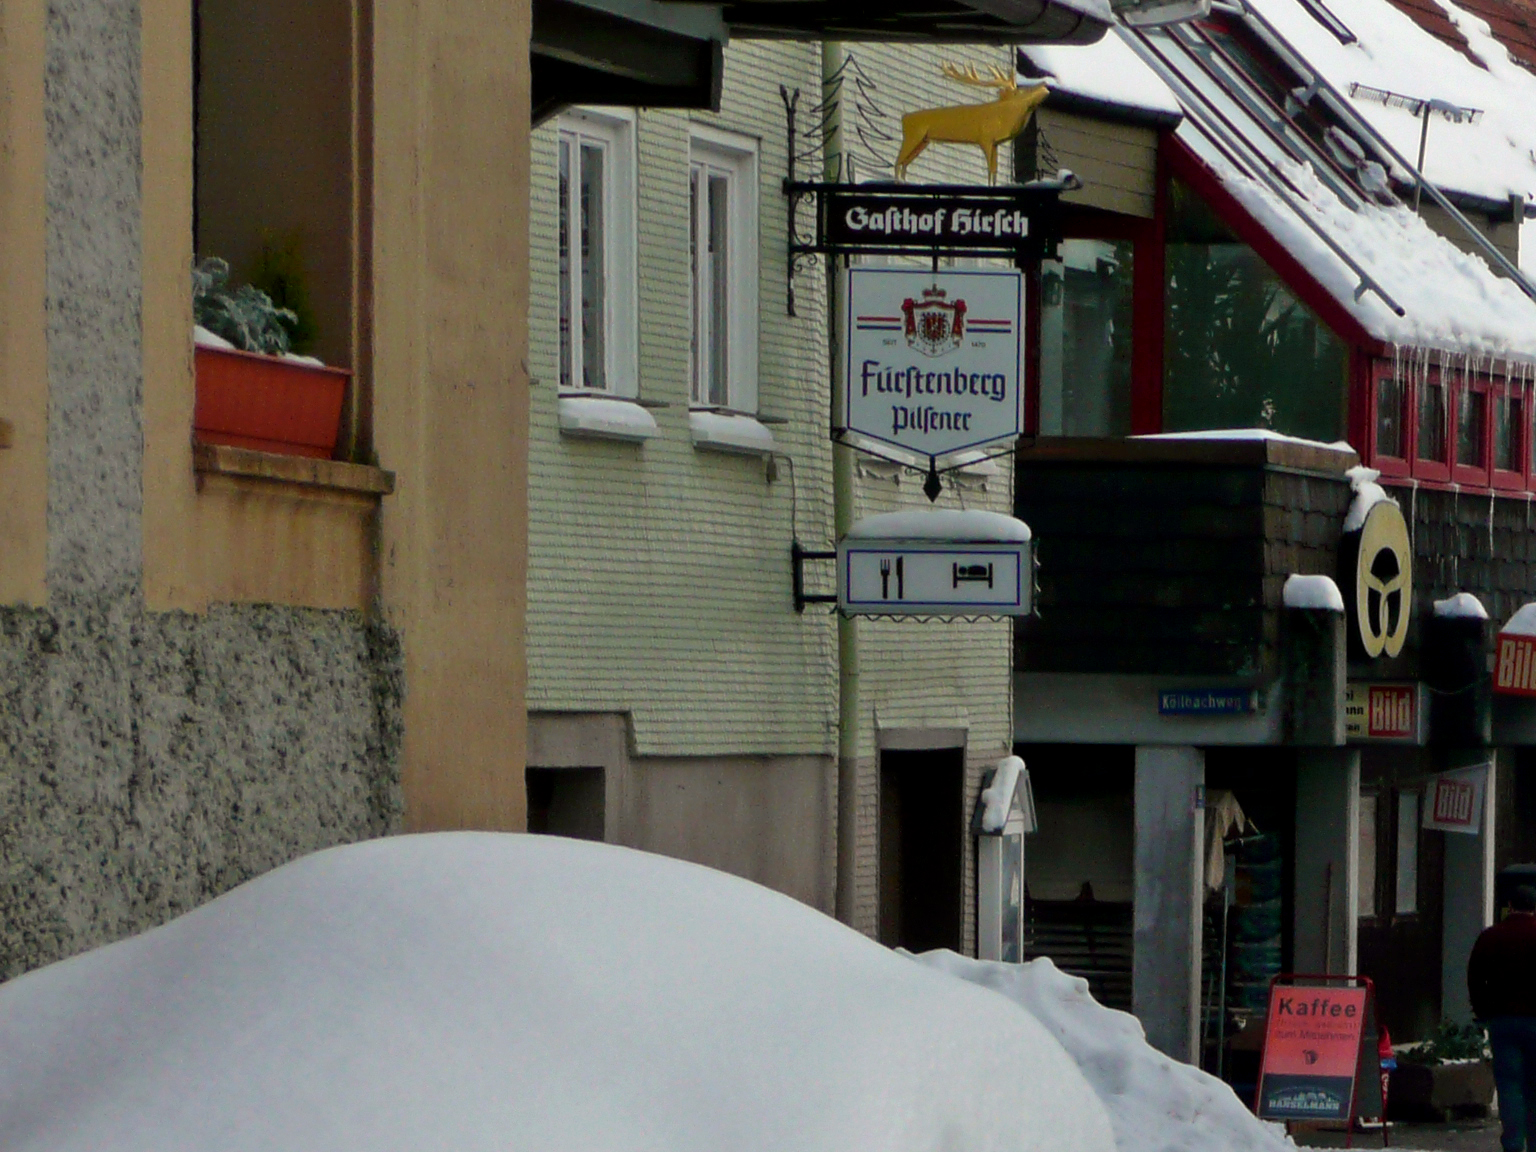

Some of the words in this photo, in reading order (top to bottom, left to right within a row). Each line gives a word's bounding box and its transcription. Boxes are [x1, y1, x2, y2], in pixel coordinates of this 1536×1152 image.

[845, 205, 947, 236] Gasthof
[950, 208, 1029, 238] Hirsch
[861, 359, 1006, 402] Fürstenberg
[891, 404, 972, 436] Pilsener
[1371, 690, 1411, 731] Bild
[1436, 783, 1471, 820] Bild
[1278, 997, 1356, 1018] Kaffee
